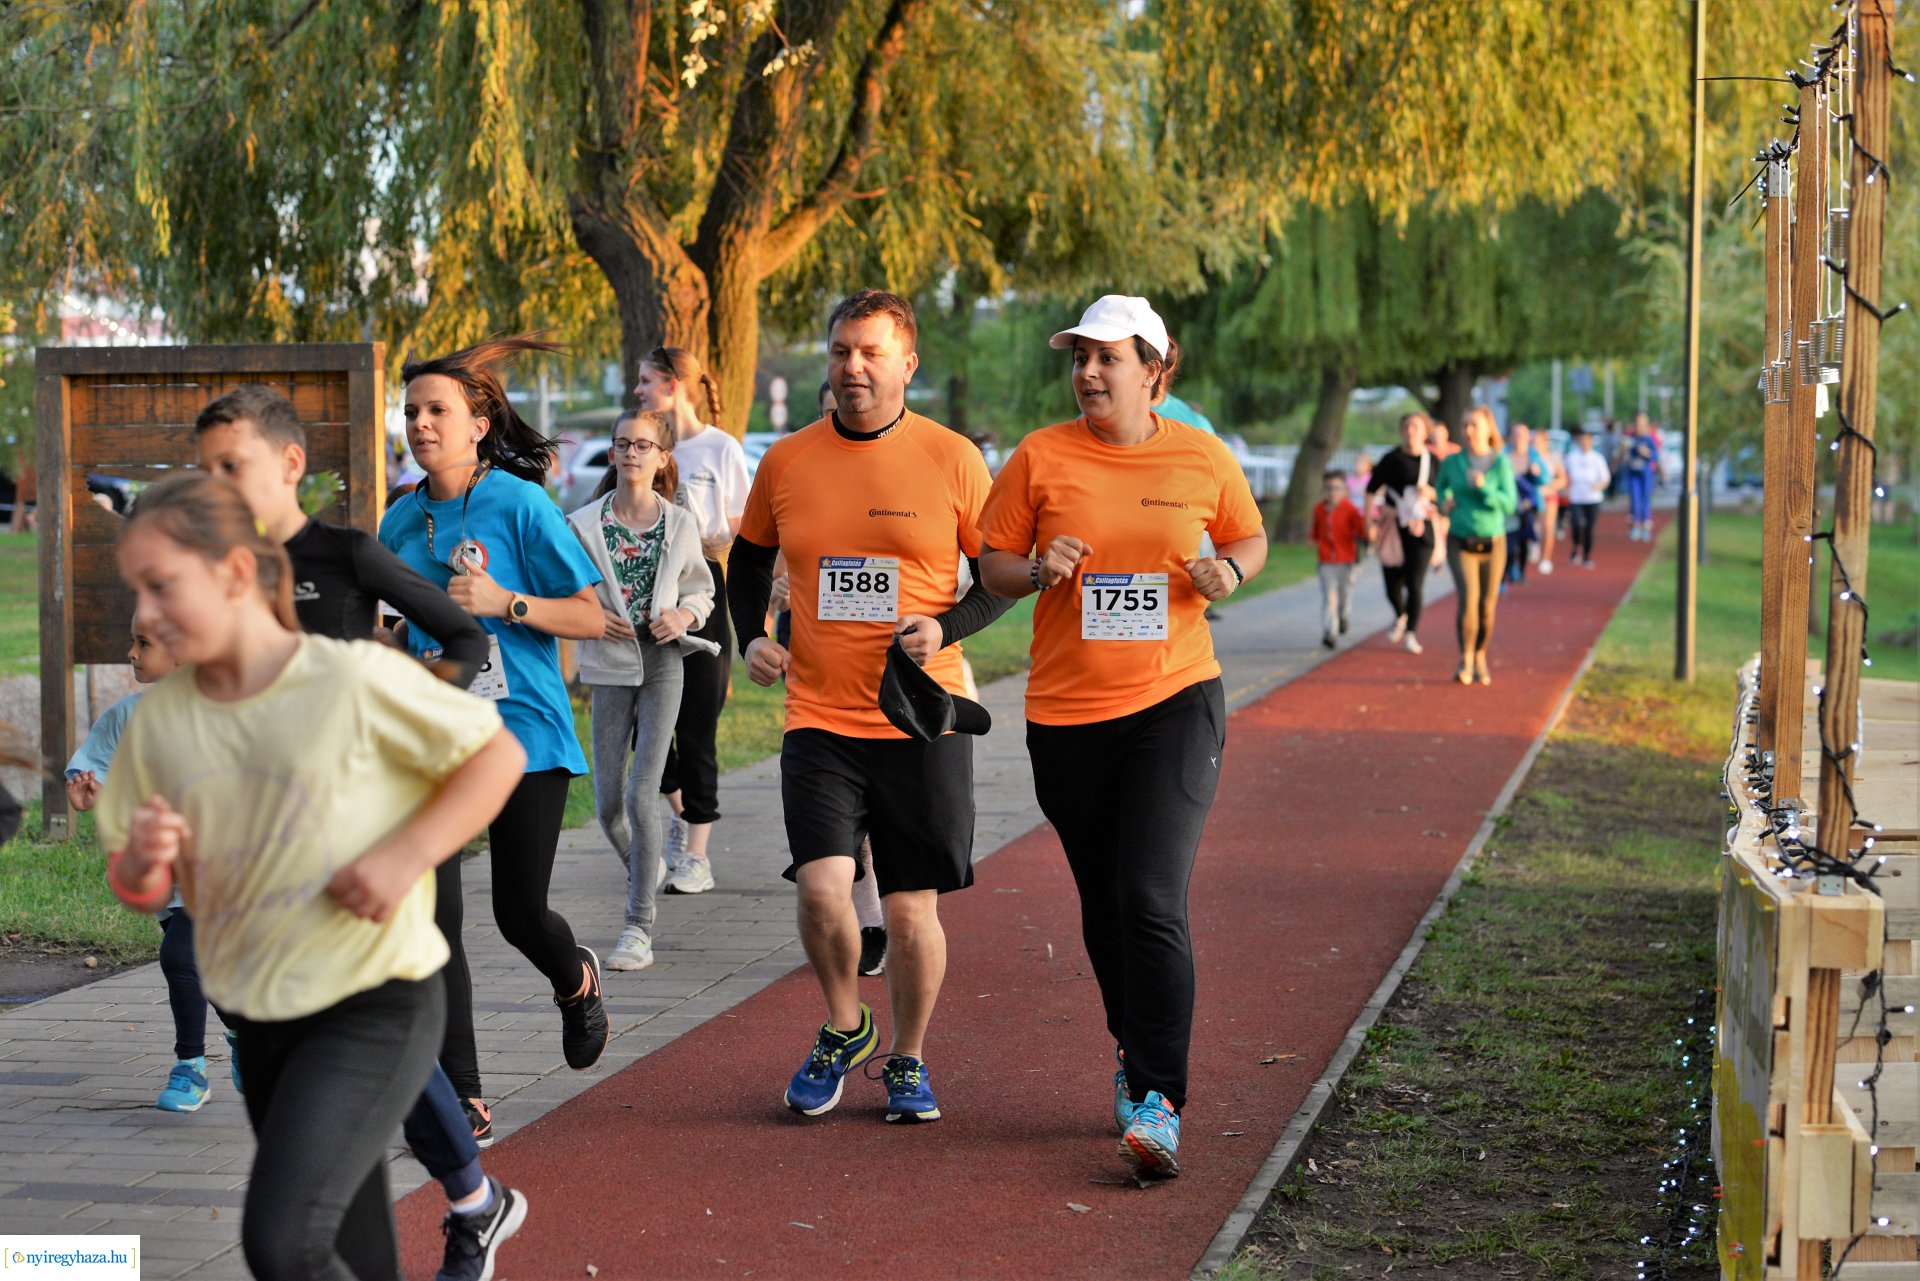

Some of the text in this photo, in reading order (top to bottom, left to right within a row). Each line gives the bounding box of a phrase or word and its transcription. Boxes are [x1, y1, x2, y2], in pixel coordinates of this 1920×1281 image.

[1141, 497, 1184, 509] Continental
[868, 508, 911, 518] Continental
[827, 571, 890, 594] 1588
[1091, 588, 1158, 611] 1755
